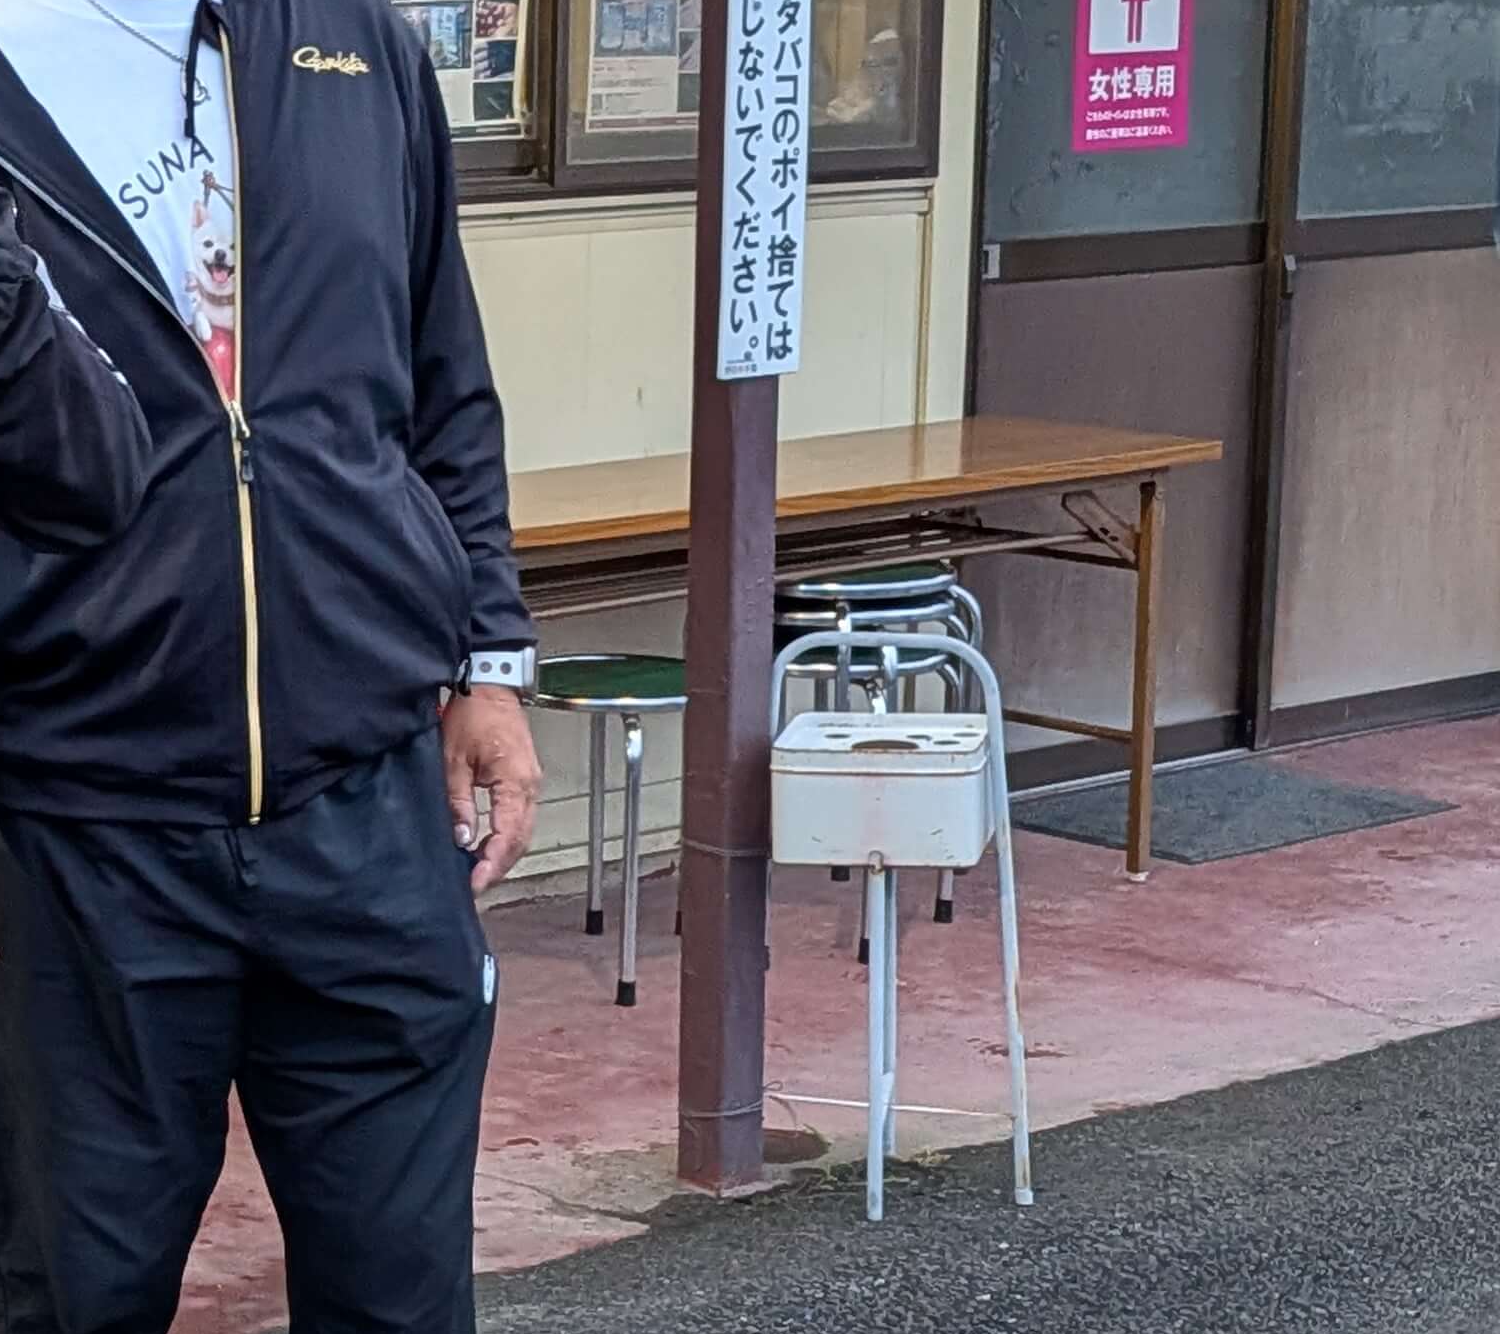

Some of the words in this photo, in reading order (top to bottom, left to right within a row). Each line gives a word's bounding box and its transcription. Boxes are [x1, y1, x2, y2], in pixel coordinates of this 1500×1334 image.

[1088, 65, 1176, 101] 女性専用
[118, 135, 215, 219] SUNA
